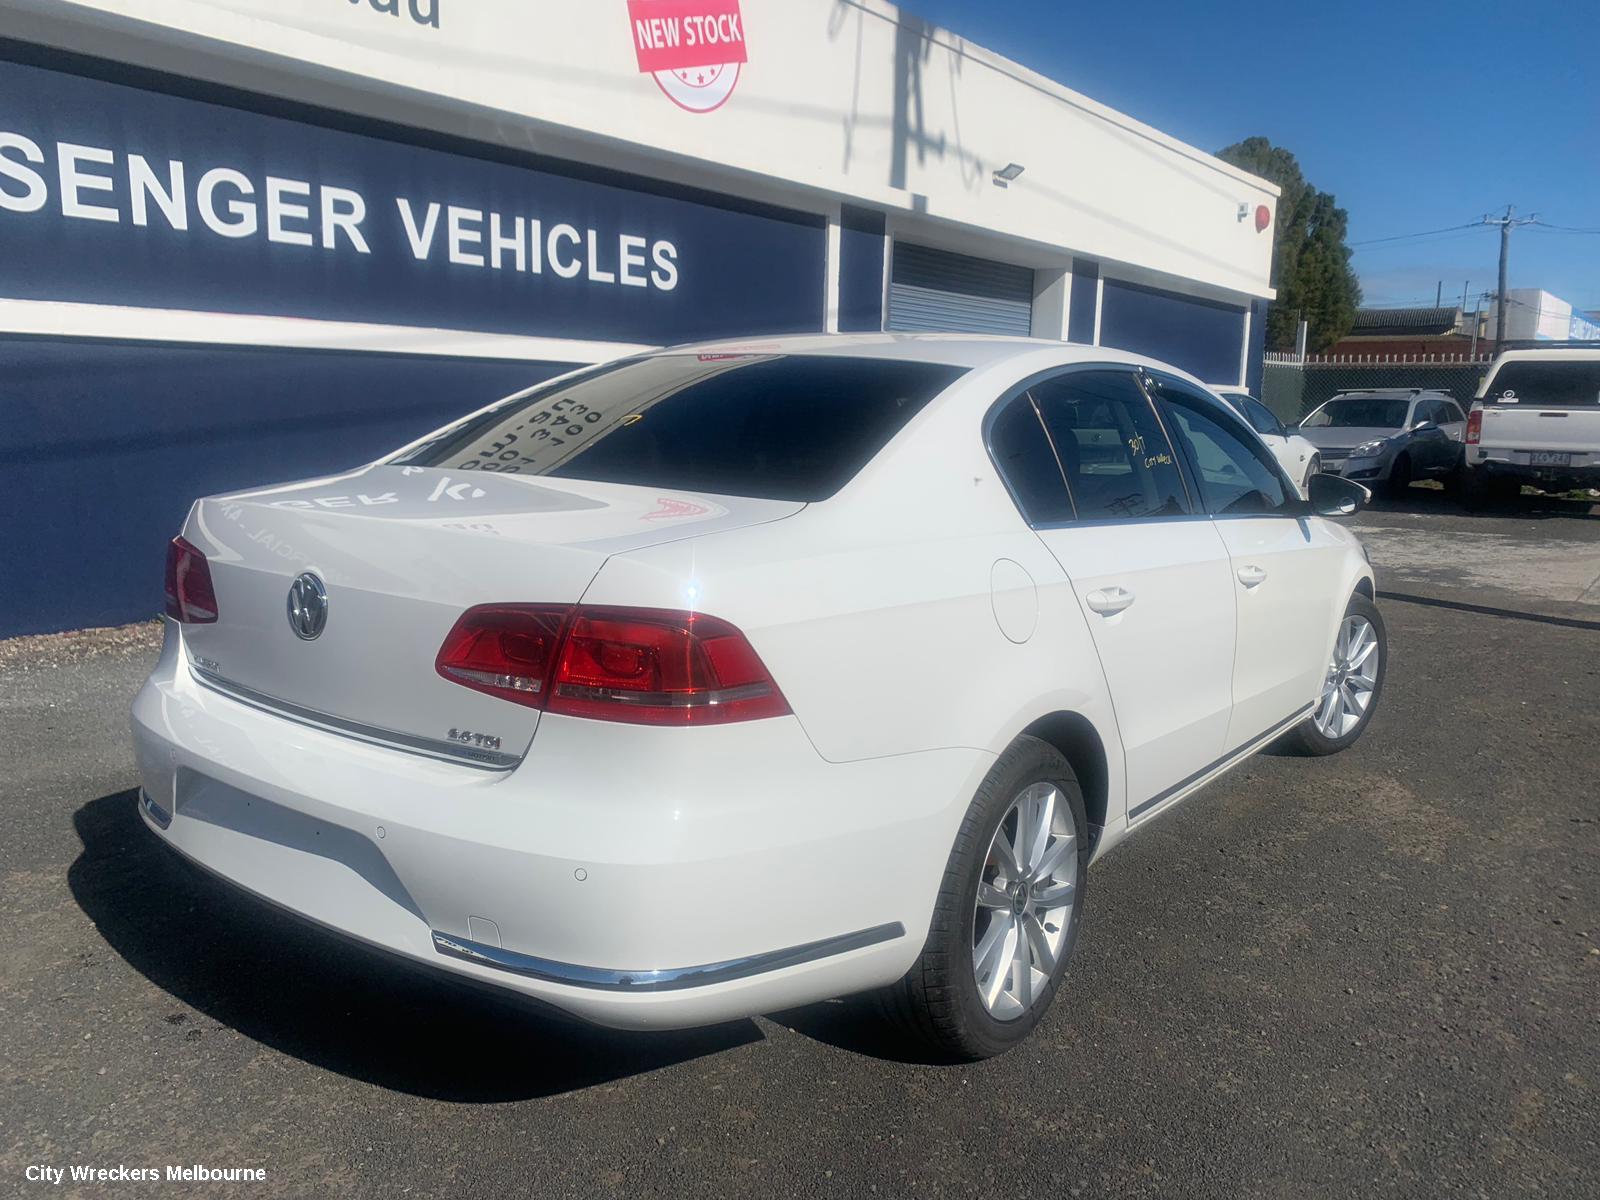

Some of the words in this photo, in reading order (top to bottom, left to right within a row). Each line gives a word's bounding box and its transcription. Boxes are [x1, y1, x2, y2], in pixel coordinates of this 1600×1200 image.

[636, 17, 680, 49] NEW
[683, 13, 742, 46] STOCK
[396, 198, 678, 290] VEHICLES
